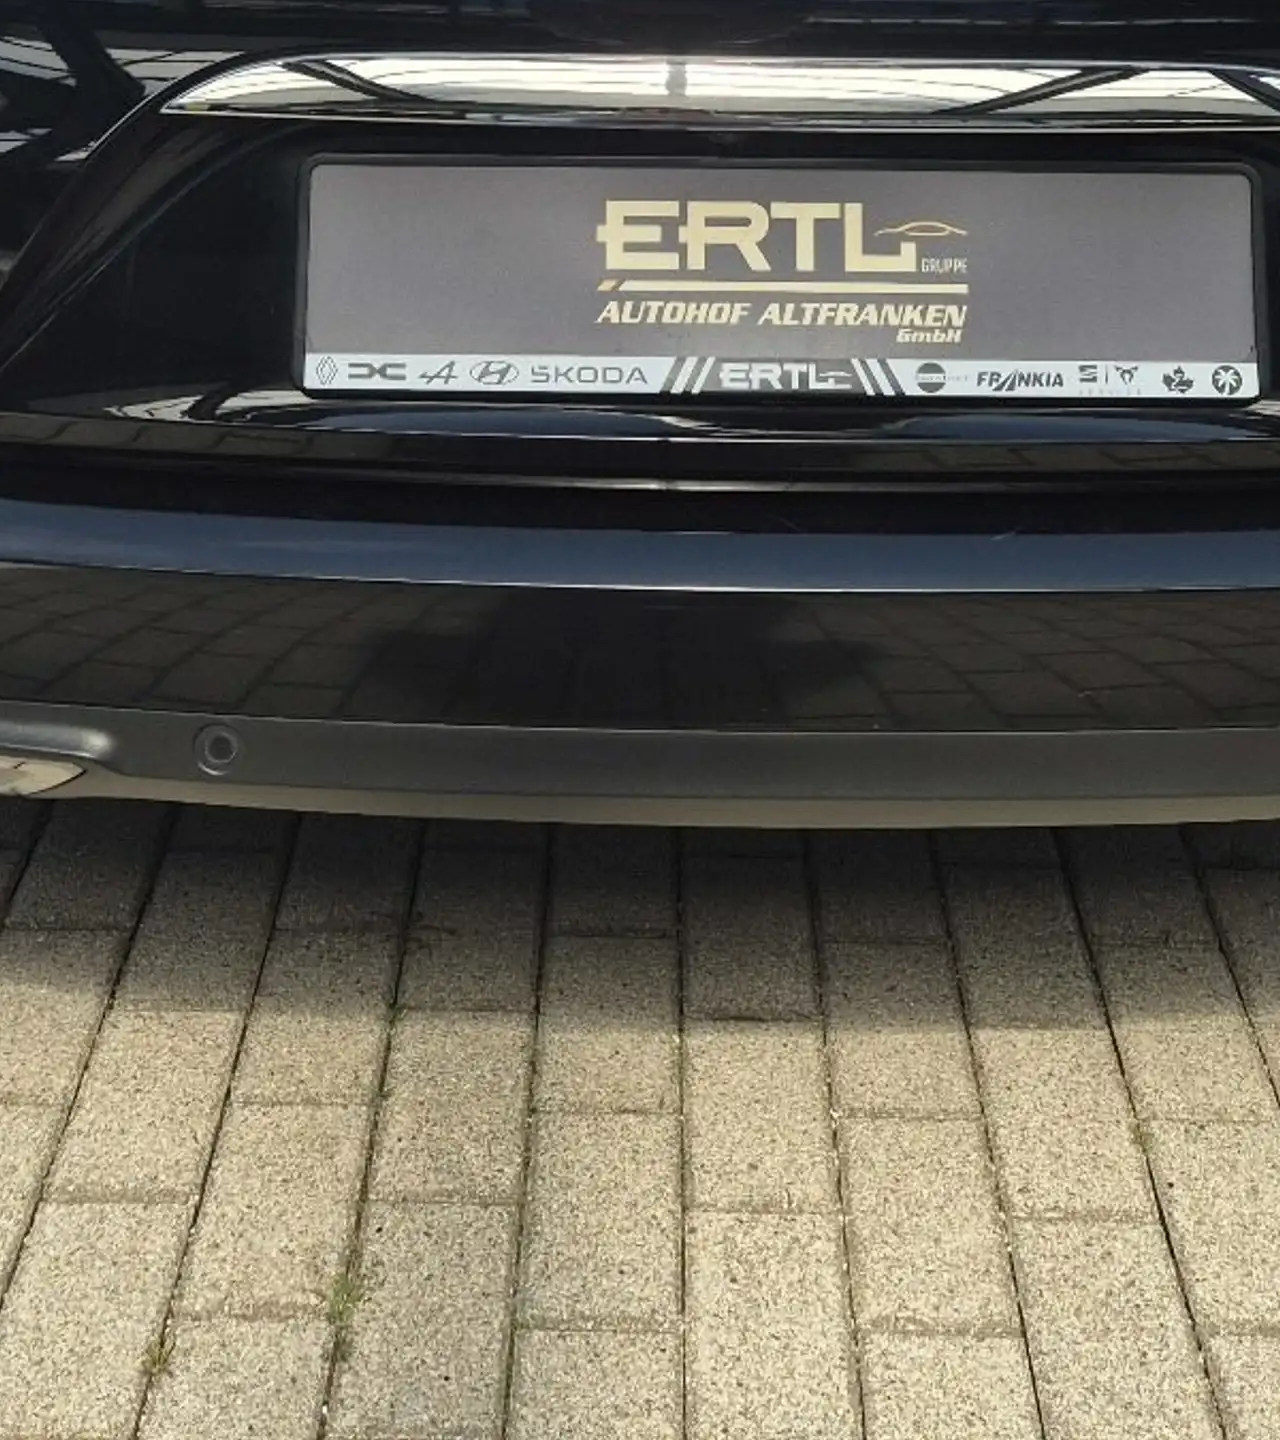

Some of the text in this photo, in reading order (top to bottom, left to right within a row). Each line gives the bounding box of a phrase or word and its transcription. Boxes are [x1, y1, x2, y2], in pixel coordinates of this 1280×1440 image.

[596, 200, 917, 272] ERTL
[921, 257, 968, 274] GRUPPE
[594, 301, 968, 327] AUTOHOF ALTFRANKEN
[896, 328, 962, 343] GmbH
[720, 362, 836, 390] ERTL
